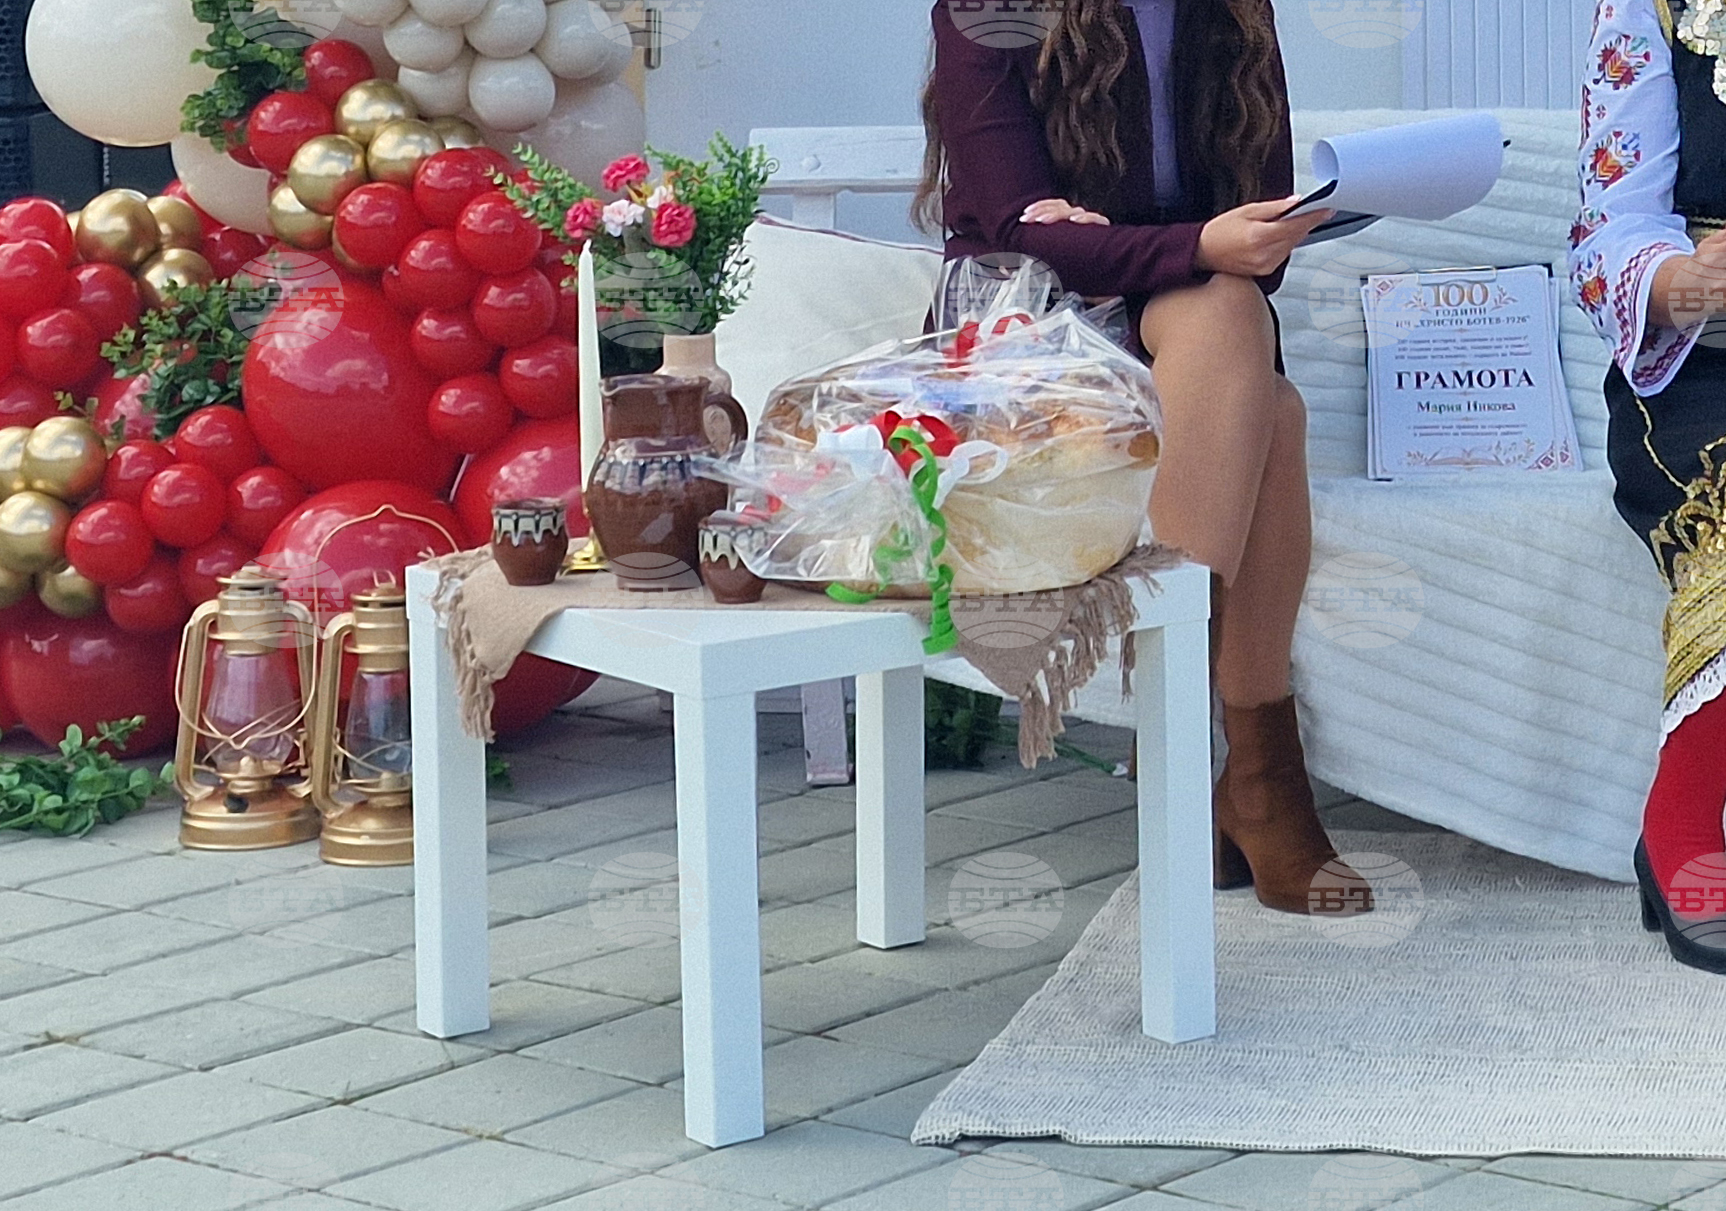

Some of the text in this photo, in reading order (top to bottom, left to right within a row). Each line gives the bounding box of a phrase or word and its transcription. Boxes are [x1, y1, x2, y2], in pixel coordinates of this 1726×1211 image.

[1432, 281, 1489, 307] 100
[1435, 307, 1487, 317] ГОДИНИ
[1395, 368, 1536, 391] ГРАМОТА
[1417, 400, 1462, 415] Мария
